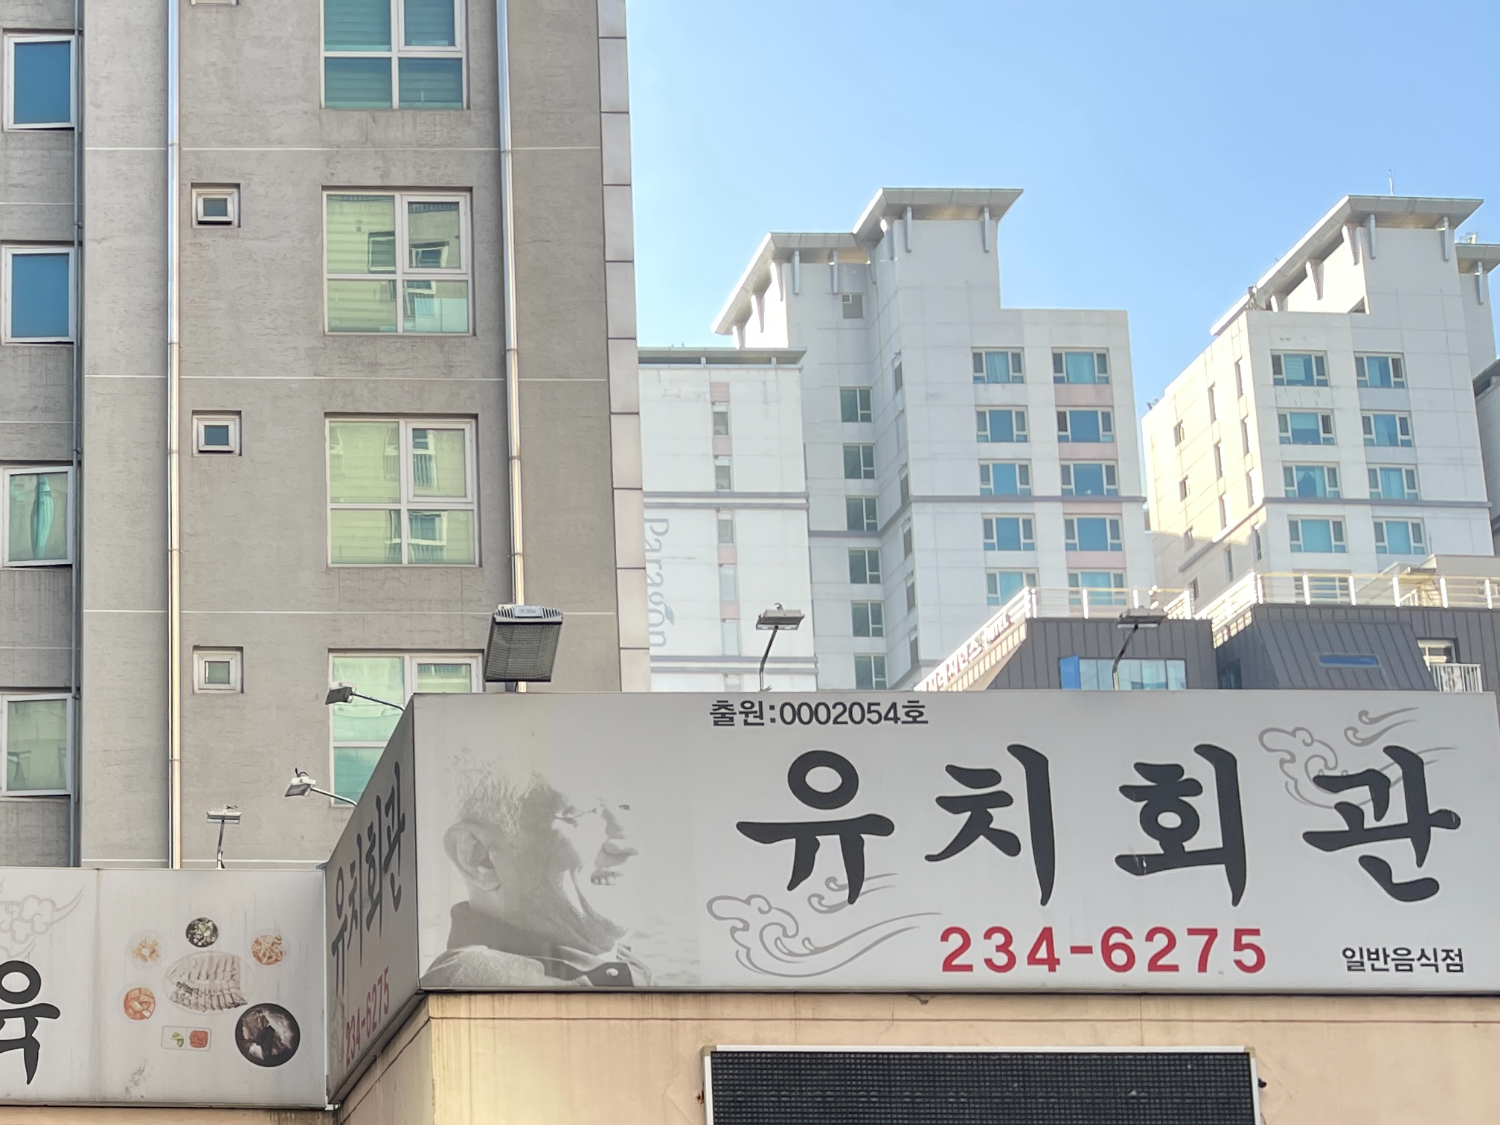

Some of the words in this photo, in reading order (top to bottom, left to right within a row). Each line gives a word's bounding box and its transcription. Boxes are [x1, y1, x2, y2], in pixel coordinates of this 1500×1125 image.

[709, 700, 929, 728] 출원:0002054호
[736, 744, 1461, 907] 유치회관
[332, 762, 405, 998] 유치회관
[940, 926, 1266, 974] 234-6275
[1342, 946, 1465, 973] 일반음식점
[345, 966, 389, 1068] 234-6275
